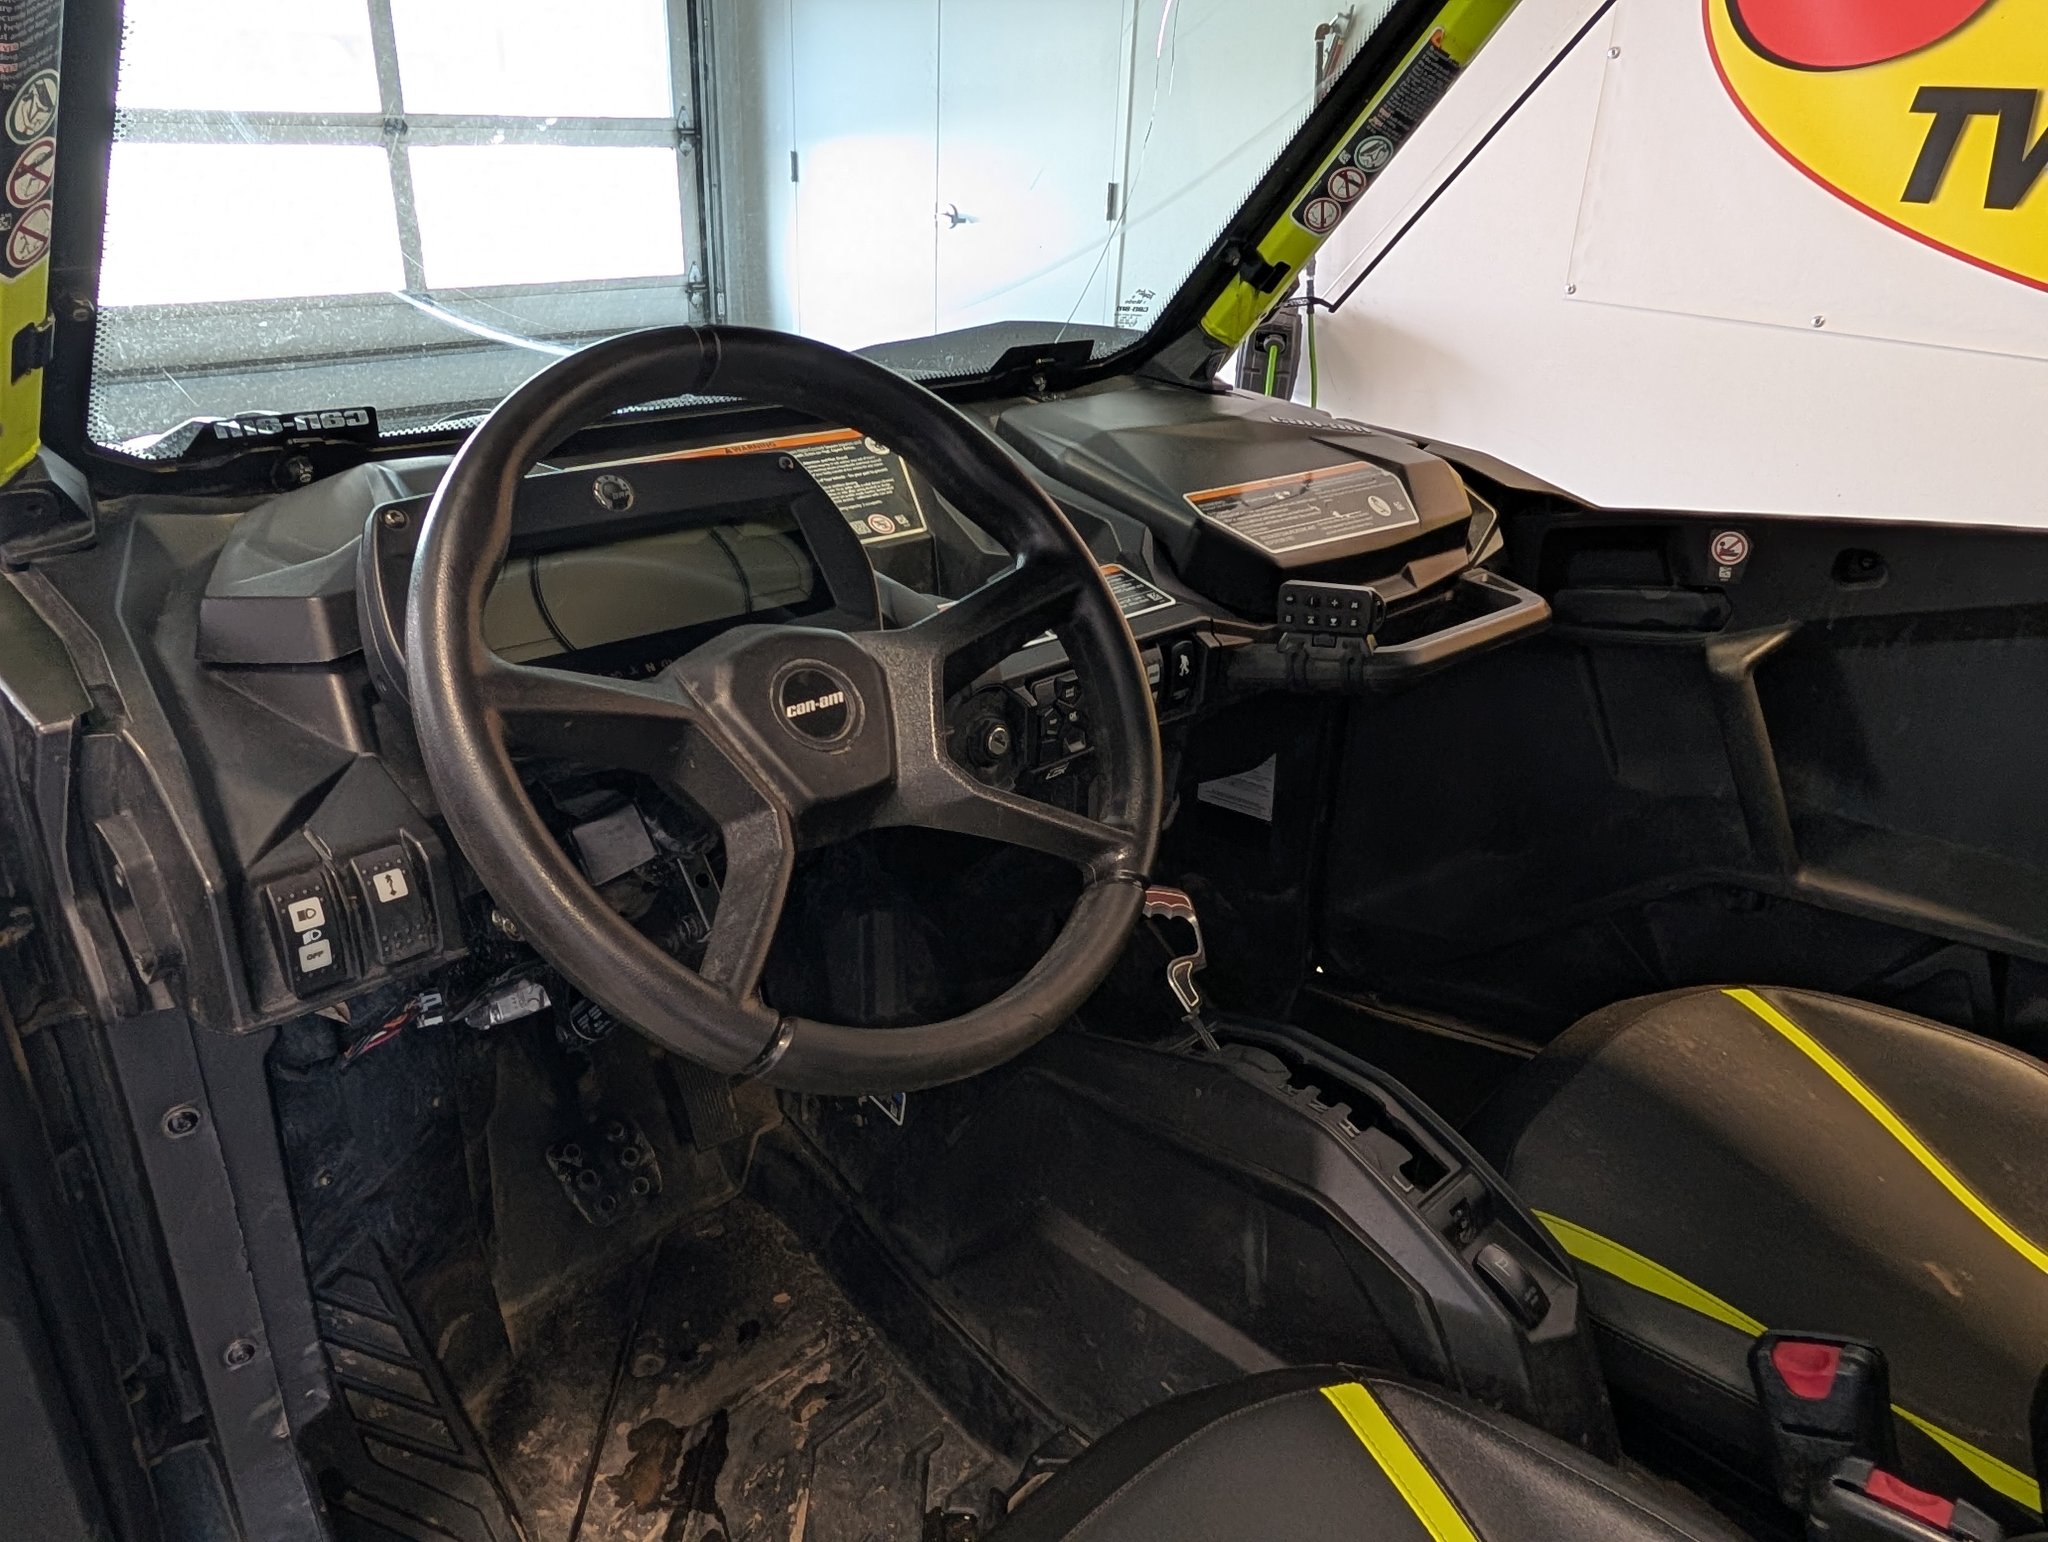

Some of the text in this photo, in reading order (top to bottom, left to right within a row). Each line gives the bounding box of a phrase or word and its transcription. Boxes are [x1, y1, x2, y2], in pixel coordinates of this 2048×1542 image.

[731, 441, 777, 454] WARNING
[786, 691, 844, 718] can-am
[306, 950, 324, 960] OFF
[1337, 1118, 1361, 1139] H
[1391, 1175, 1415, 1193] L
